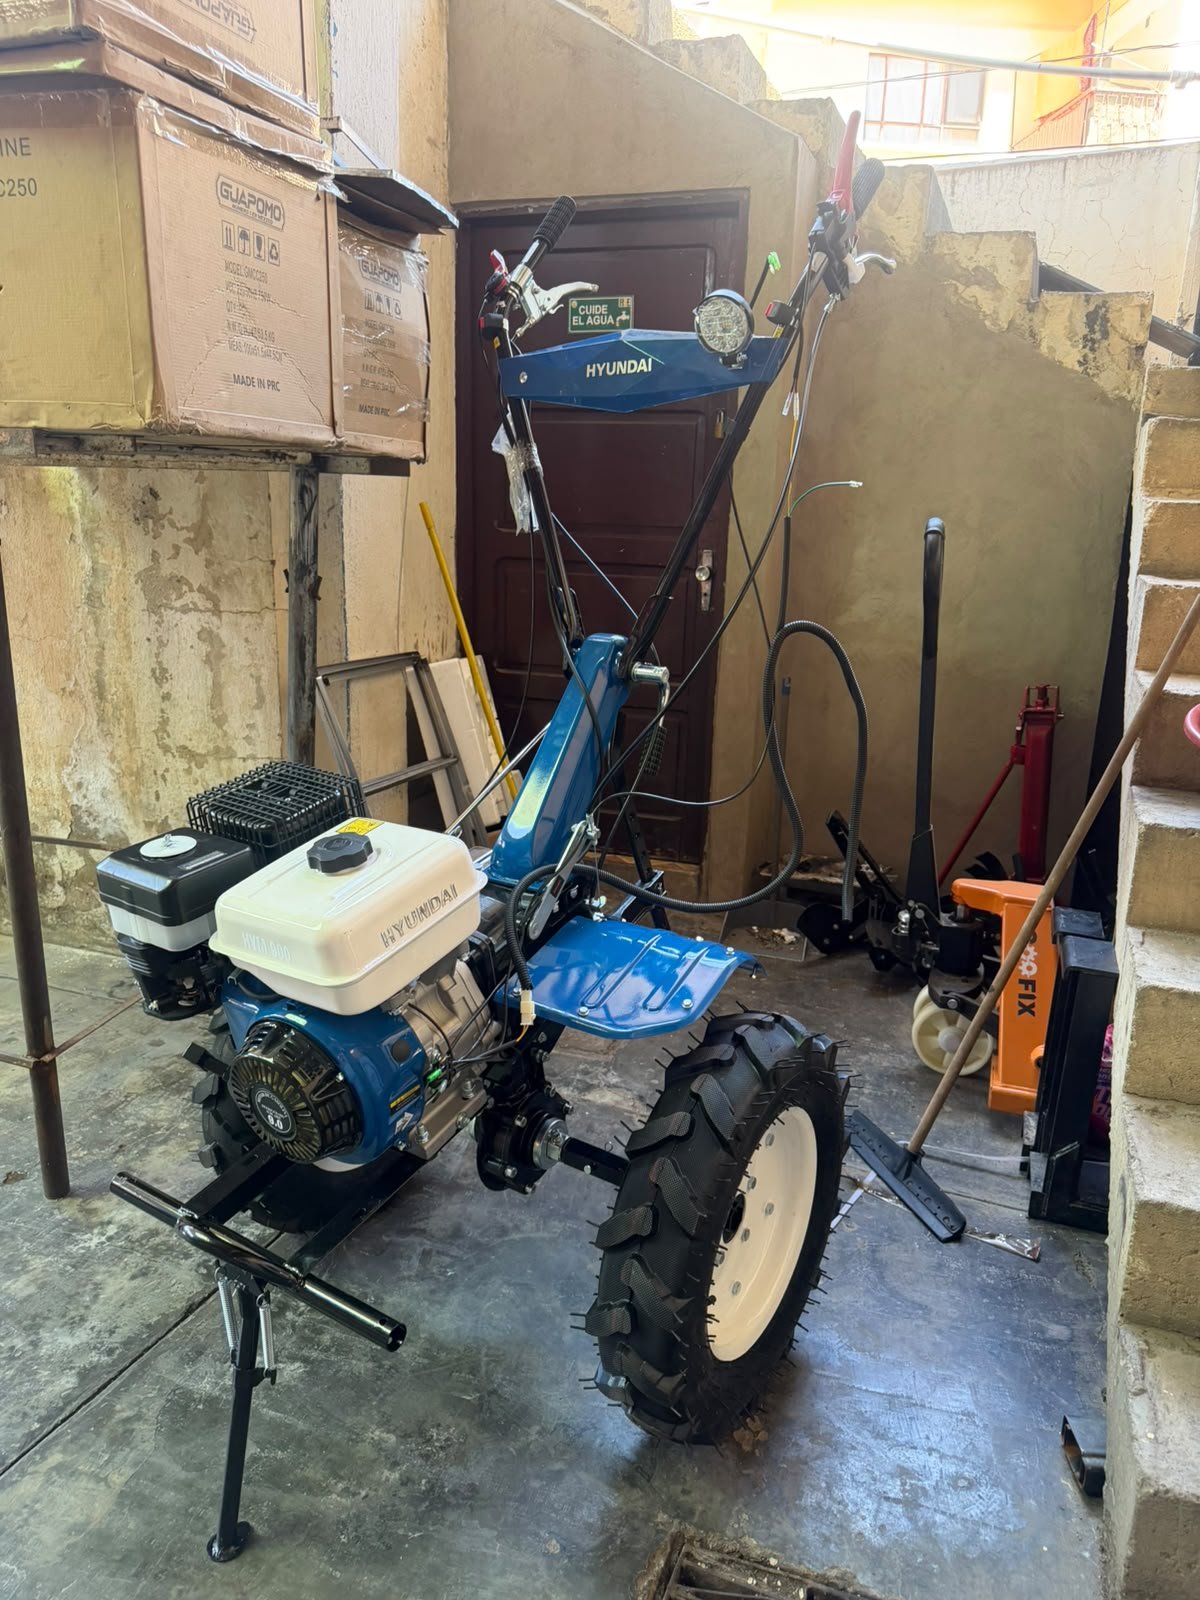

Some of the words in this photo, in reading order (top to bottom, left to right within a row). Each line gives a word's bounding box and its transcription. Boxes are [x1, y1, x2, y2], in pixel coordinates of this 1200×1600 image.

[220, 180, 282, 222] GUAPOMO
[572, 315, 584, 326] EL
[586, 314, 615, 325] AGUA
[578, 304, 608, 315] CUIDE
[586, 357, 652, 378] HYUNDAI
[232, 373, 256, 388] MADE
[256, 377, 266, 390] IN
[267, 379, 281, 392] PRC
[380, 883, 458, 949] HYUNDAI
[1018, 978, 1037, 1017] FIX
